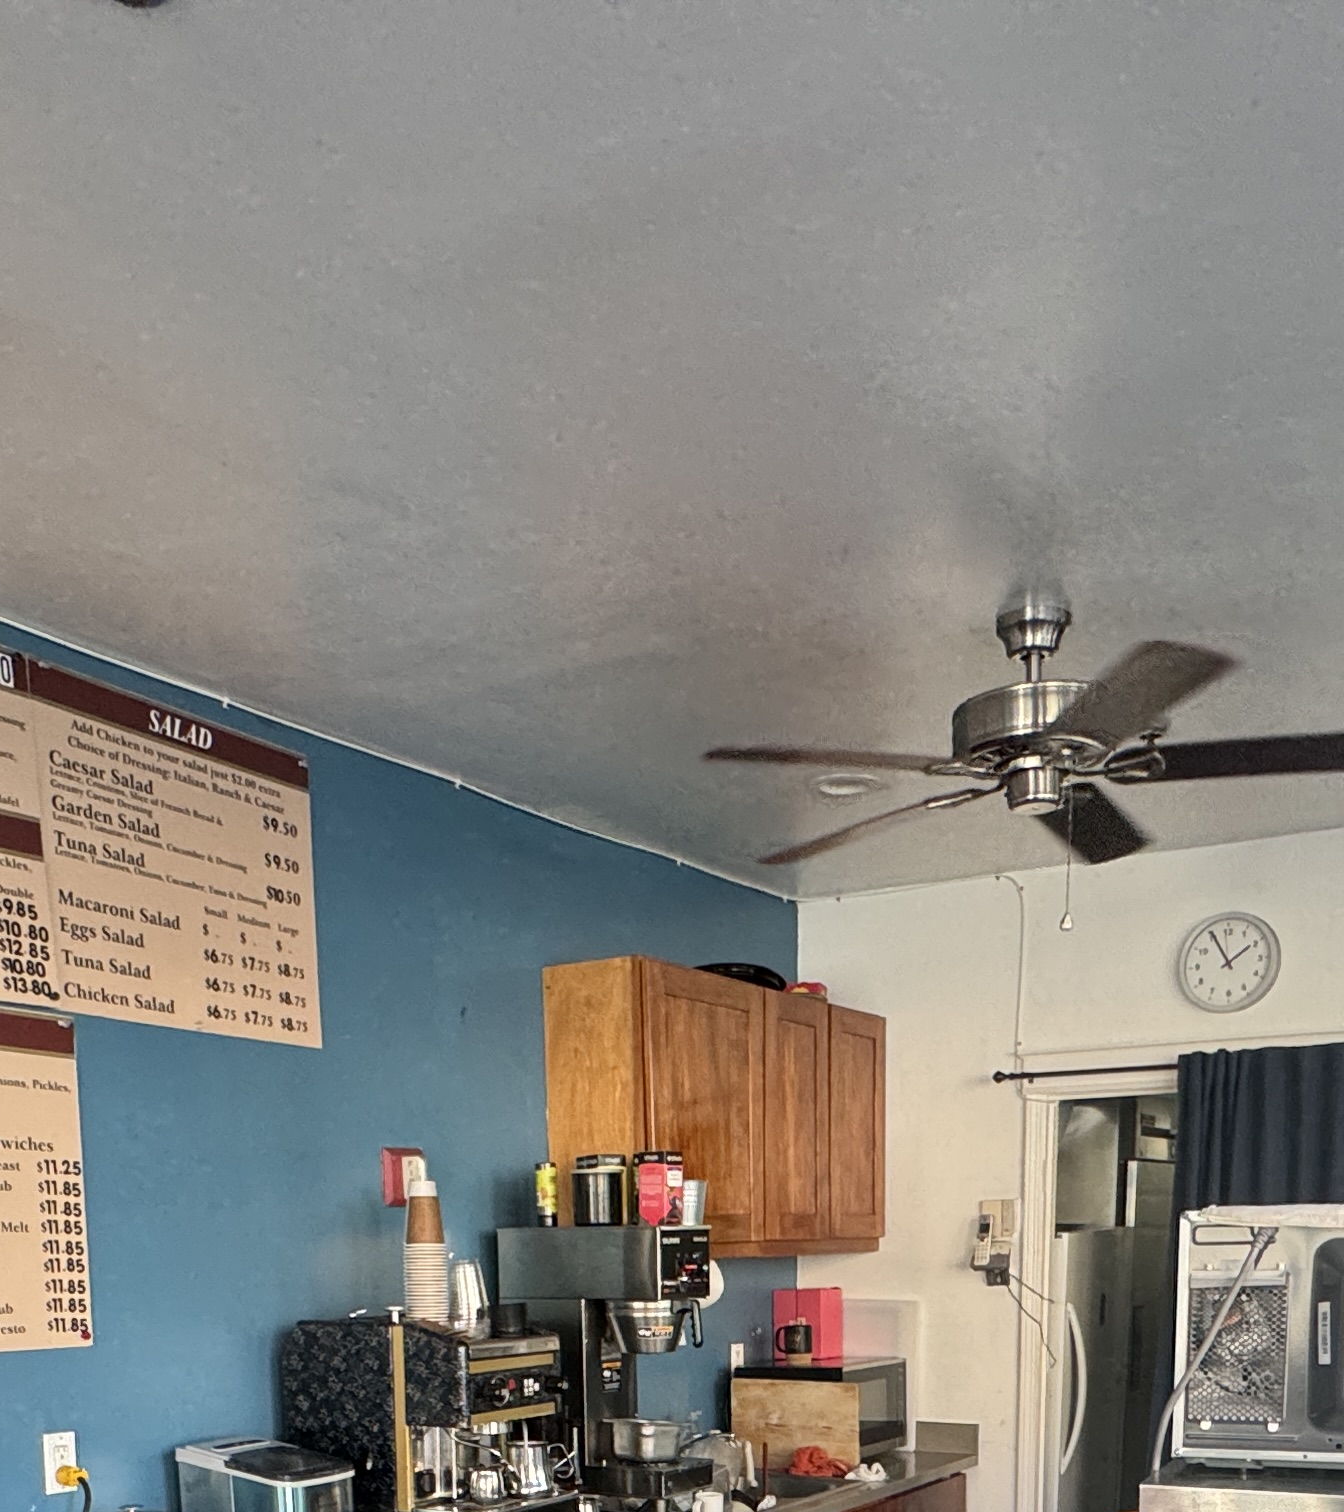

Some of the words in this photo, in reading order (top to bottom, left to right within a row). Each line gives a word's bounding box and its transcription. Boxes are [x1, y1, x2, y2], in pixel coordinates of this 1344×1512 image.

[149, 709, 212, 749] SALAD
[48, 749, 107, 782] Caesar
[110, 768, 155, 796] Salad
[51, 794, 114, 826] Garden
[117, 812, 161, 839] Salad
[53, 829, 98, 857] Tuna
[102, 842, 146, 868] Salad
